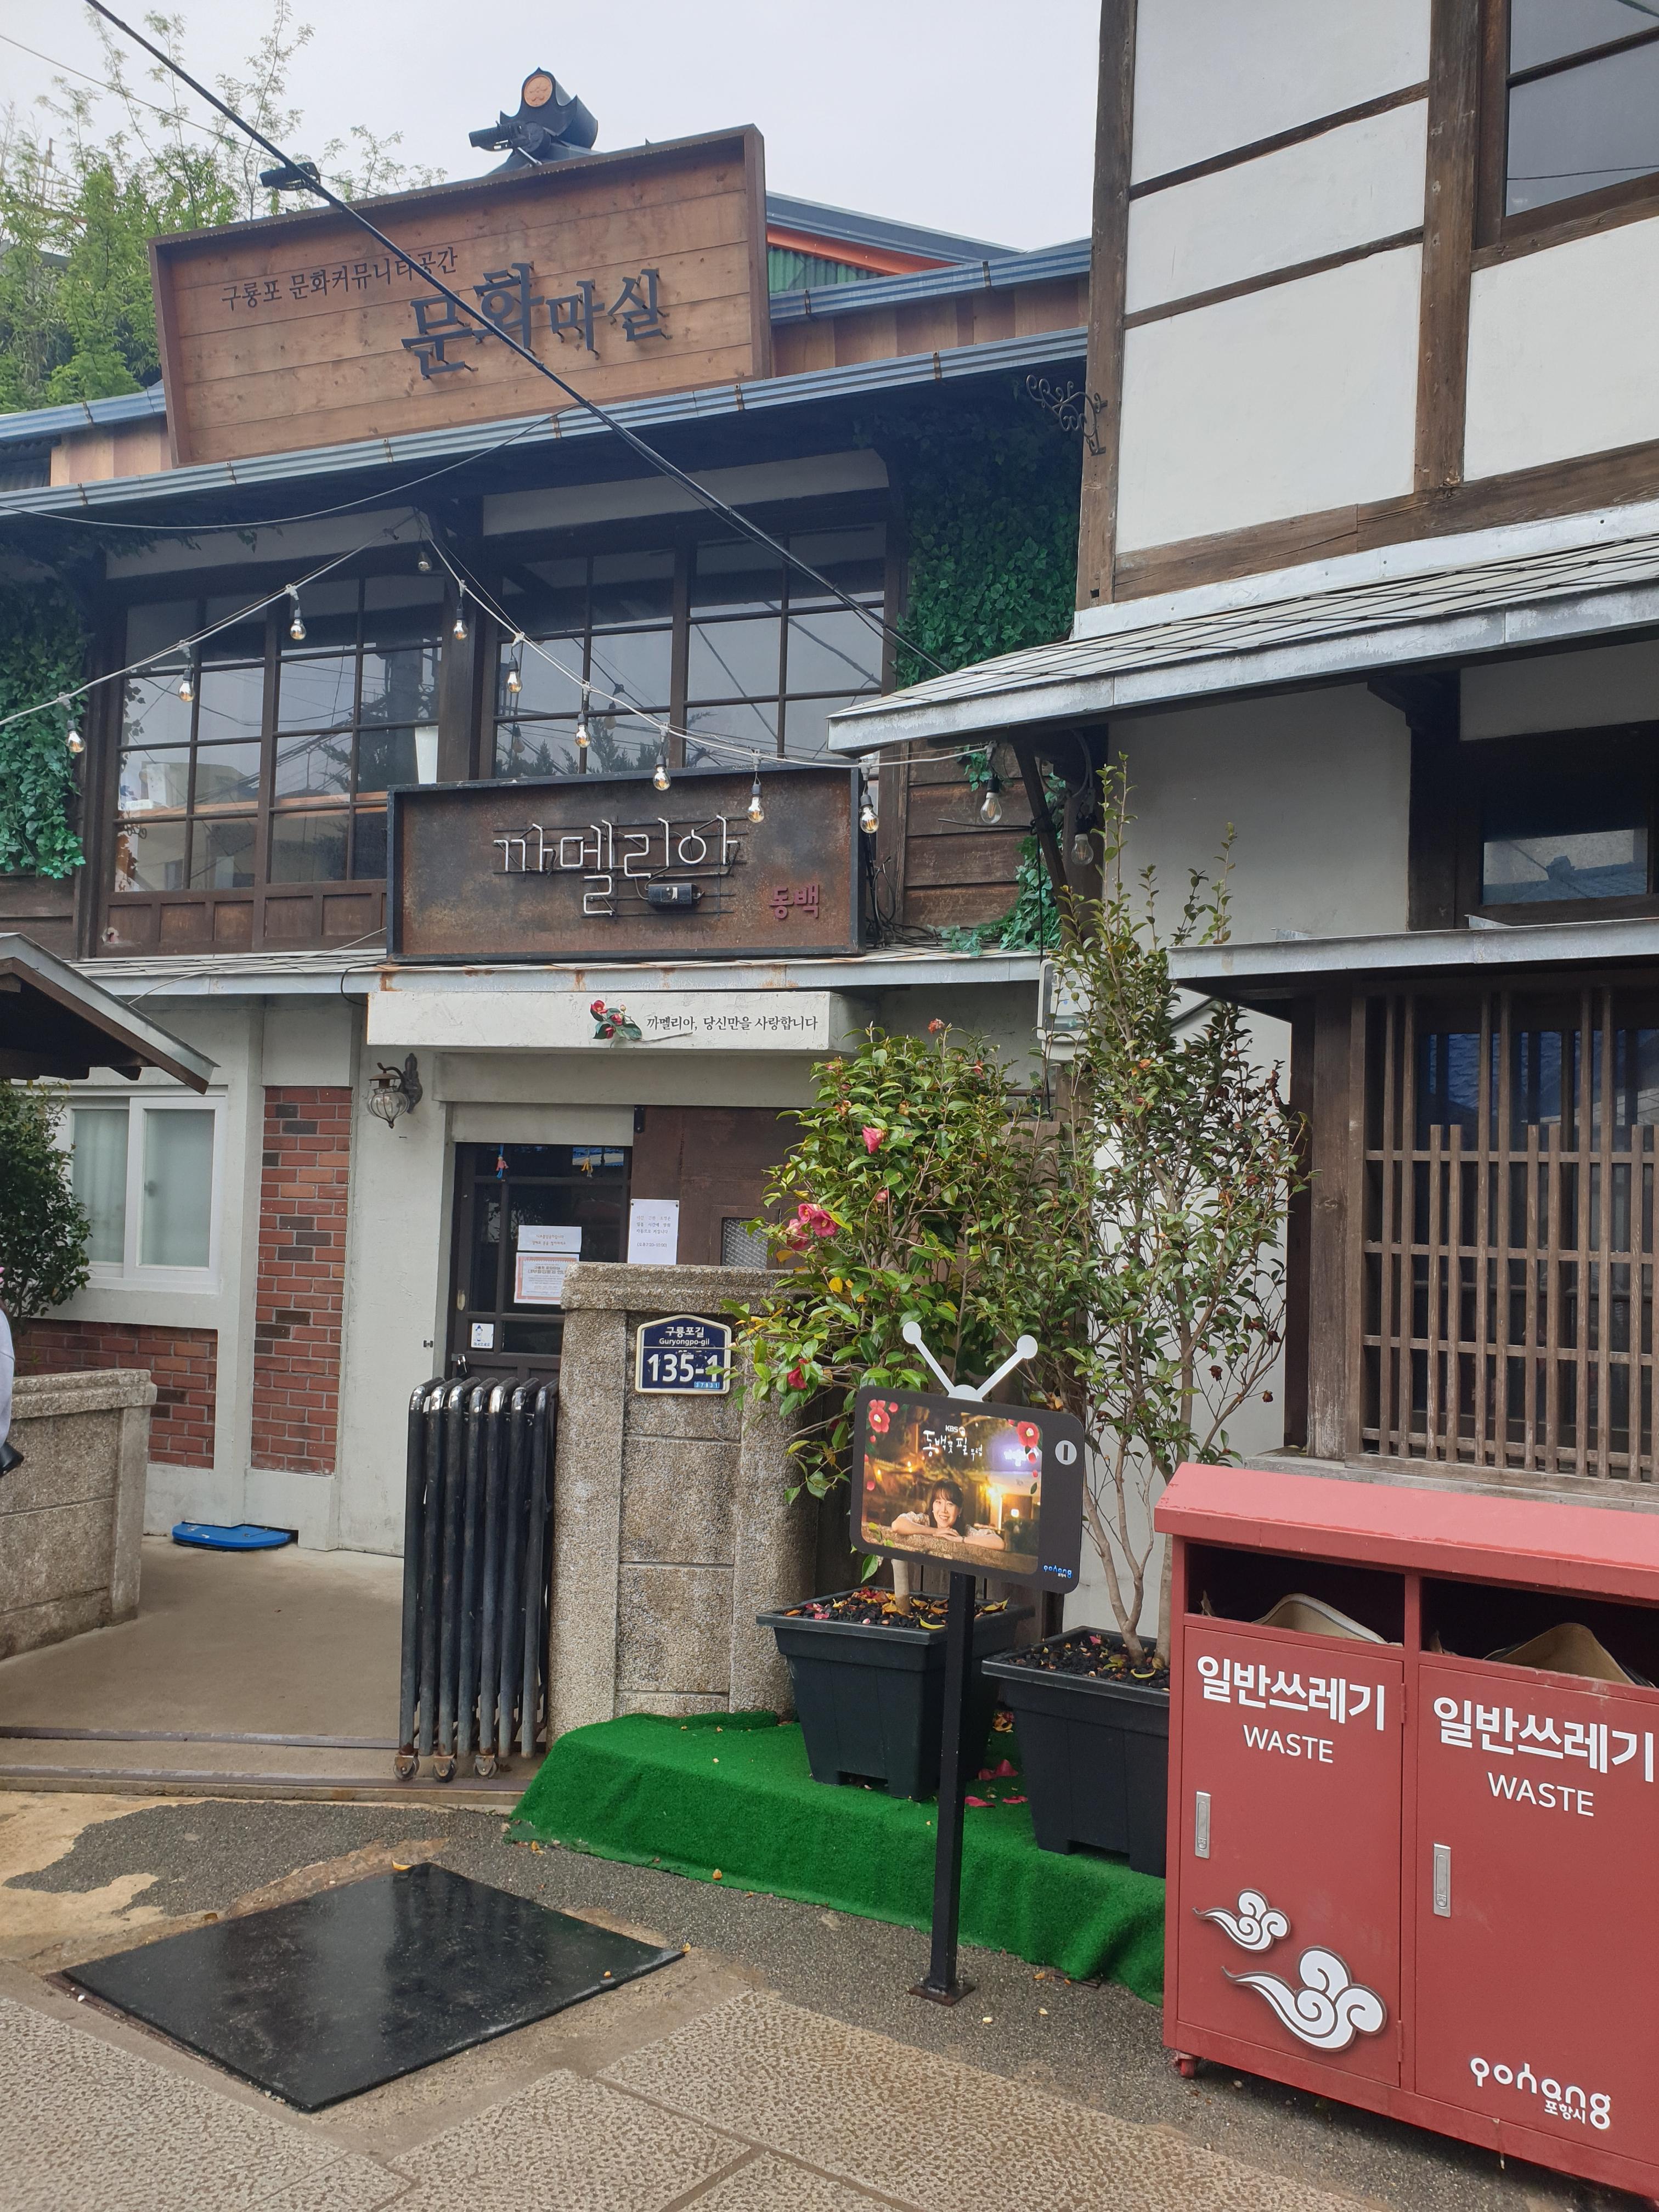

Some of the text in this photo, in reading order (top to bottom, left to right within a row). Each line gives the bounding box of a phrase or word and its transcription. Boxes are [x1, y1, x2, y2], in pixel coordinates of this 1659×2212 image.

[221, 246, 459, 312] 구룡포 문화커뮤니티공간
[400, 262, 660, 377] 문화마실
[493, 814, 738, 916] 까멜리아
[769, 883, 820, 919] 동백
[646, 1015, 819, 1031] 까멜리아, 당신만을 사랑합니다
[659, 1338, 710, 1346] Guryongpo-gil
[665, 1326, 704, 1338] 구룡포길
[647, 1353, 718, 1383] 135-1
[922, 1430, 953, 1457] 동백꽃
[956, 1437, 968, 1455] 필
[970, 1443, 983, 1462] 무렵
[945, 1424, 958, 1433] KBS
[1197, 1655, 1385, 1731] 일반쓰레기
[1243, 1724, 1334, 1764] WASTE
[1432, 1696, 1655, 1783] 일반쓰레기
[1487, 1771, 1595, 1817] WASTE
[1470, 2057, 1612, 2130] pohang
[1544, 2099, 1586, 2125] 포항시
